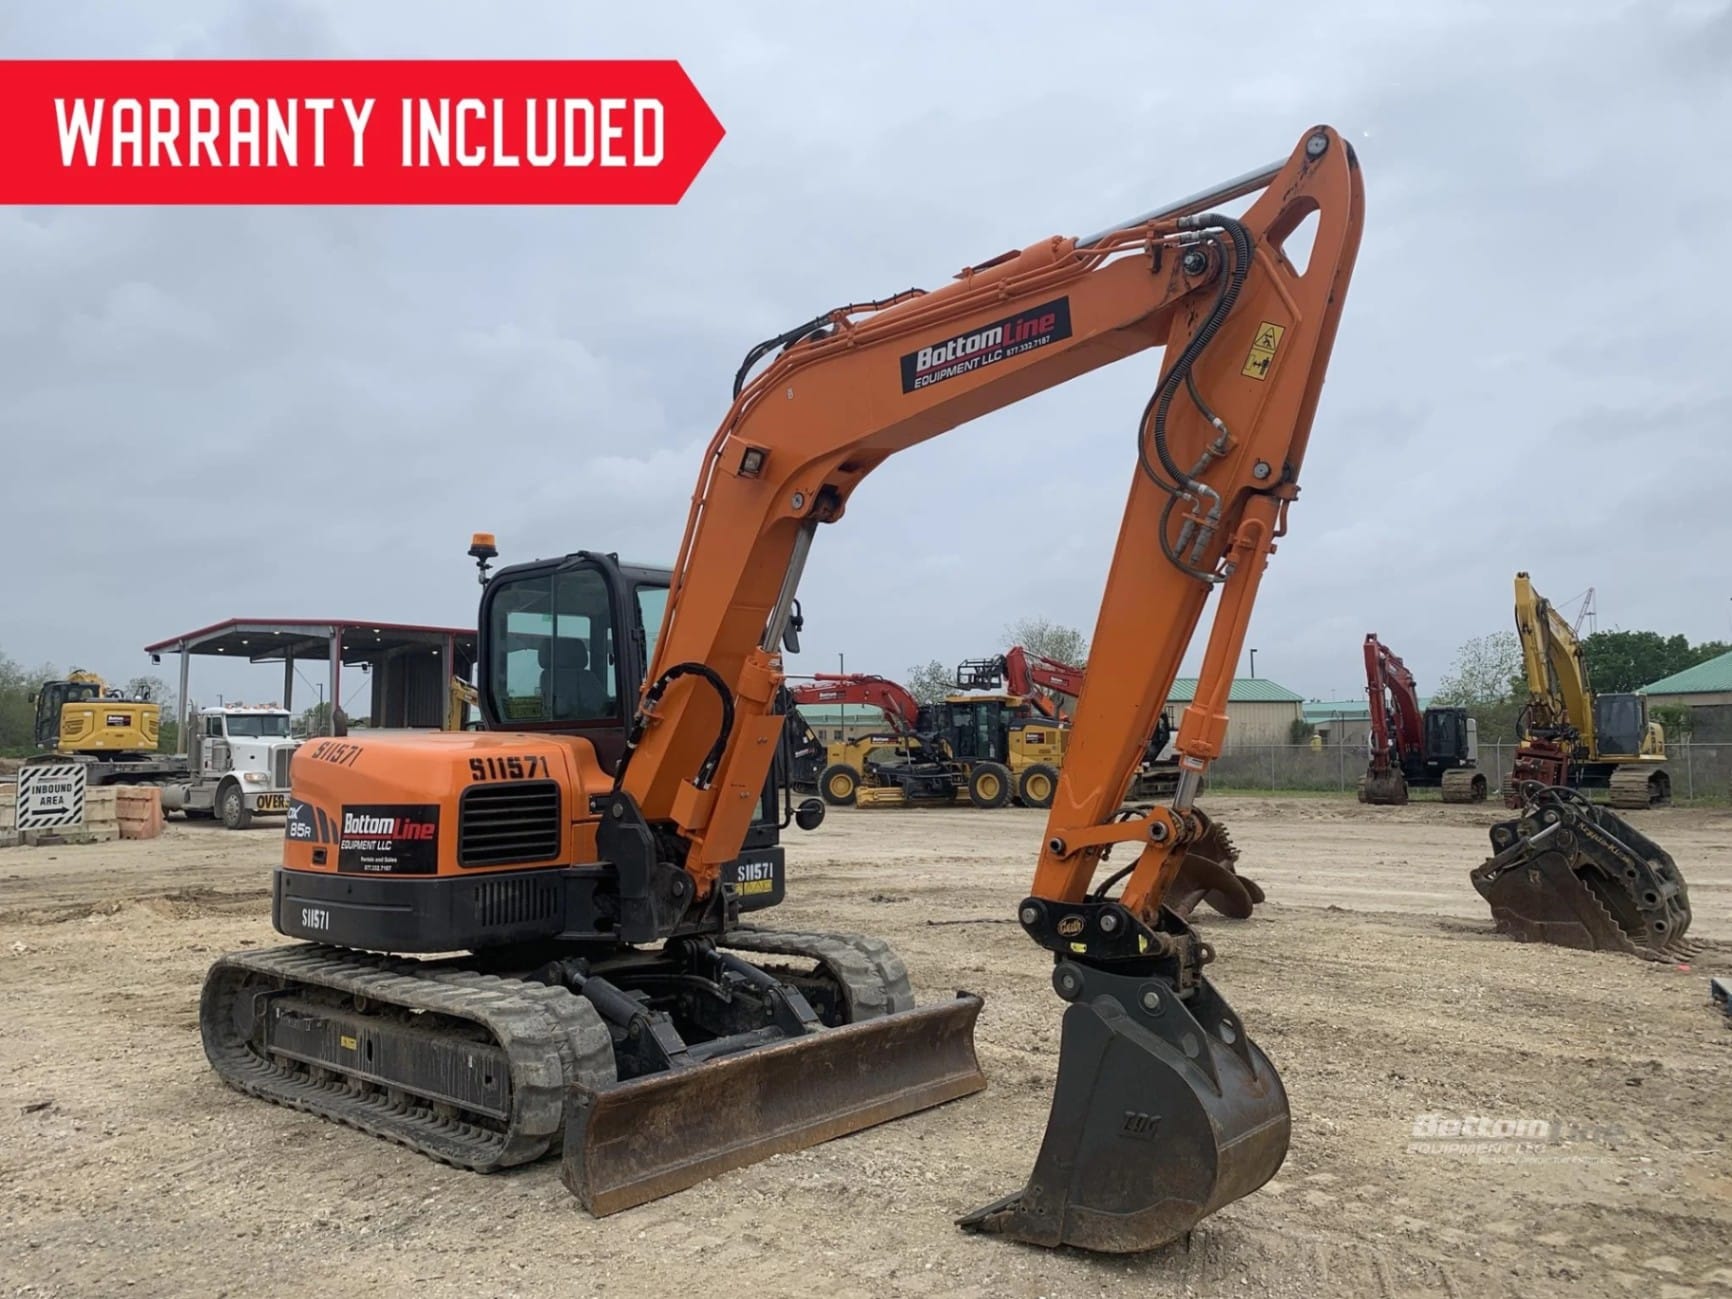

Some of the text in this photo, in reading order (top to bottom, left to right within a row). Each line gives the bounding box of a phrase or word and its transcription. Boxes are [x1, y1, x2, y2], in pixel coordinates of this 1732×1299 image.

[914, 357, 981, 389] EQUIPMENT
[982, 349, 1003, 366] LLC
[311, 741, 364, 767] S11571
[469, 756, 550, 781] S11571
[31, 783, 73, 795] INBOUND
[39, 796, 65, 806] AREA
[290, 822, 312, 838] 85R
[340, 840, 392, 851] EQUIPMENT LLC
[737, 862, 774, 882] S11571
[301, 908, 330, 931] S11571
